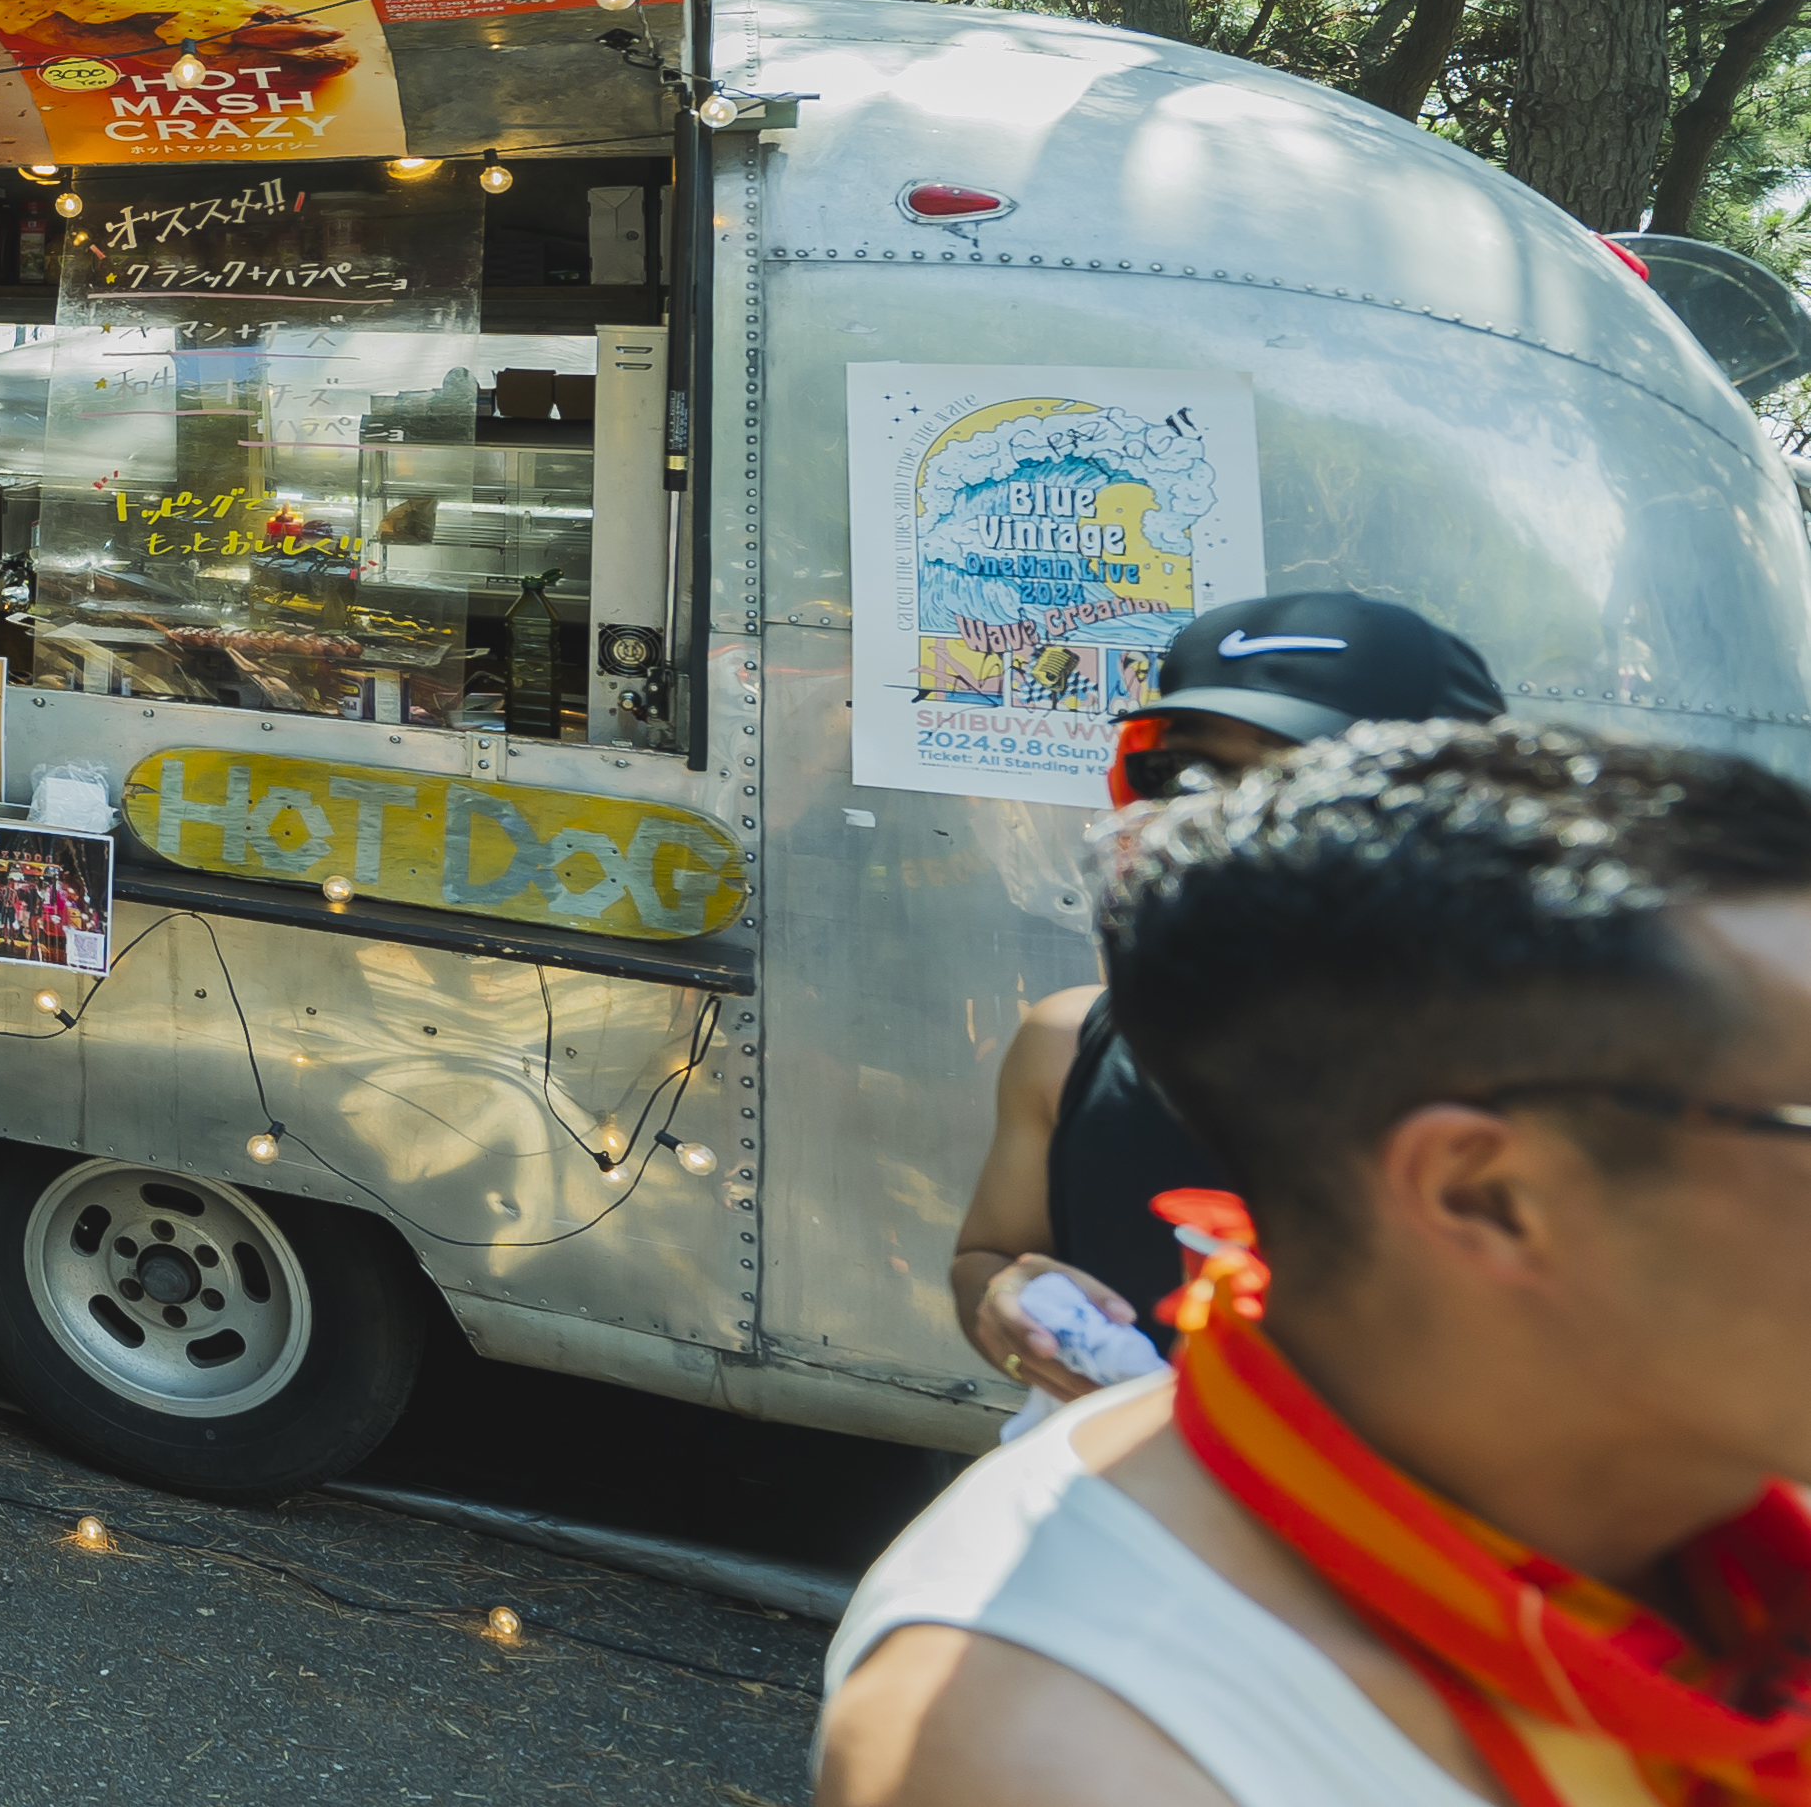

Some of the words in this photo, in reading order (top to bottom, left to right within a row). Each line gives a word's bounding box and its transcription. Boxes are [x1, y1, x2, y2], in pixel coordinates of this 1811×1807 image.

[49, 68, 105, 81] 3000
[130, 67, 282, 93] HOT
[109, 92, 316, 118] MASH
[104, 116, 338, 142] CRAZY
[129, 142, 320, 154] ホットマッシュクレイジー
[1008, 481, 1098, 518] Blue
[976, 514, 1127, 556] Vintage
[1019, 582, 1086, 606] 2024
[954, 613, 1039, 654] Wave
[1045, 596, 1172, 638] Creation
[916, 708, 1055, 739] SHIBUYA
[917, 728, 1109, 762] 2024.9.8(Sun)
[918, 749, 974, 765] Ticket:
[978, 755, 1001, 768] All
[1004, 757, 1080, 776] Standing
